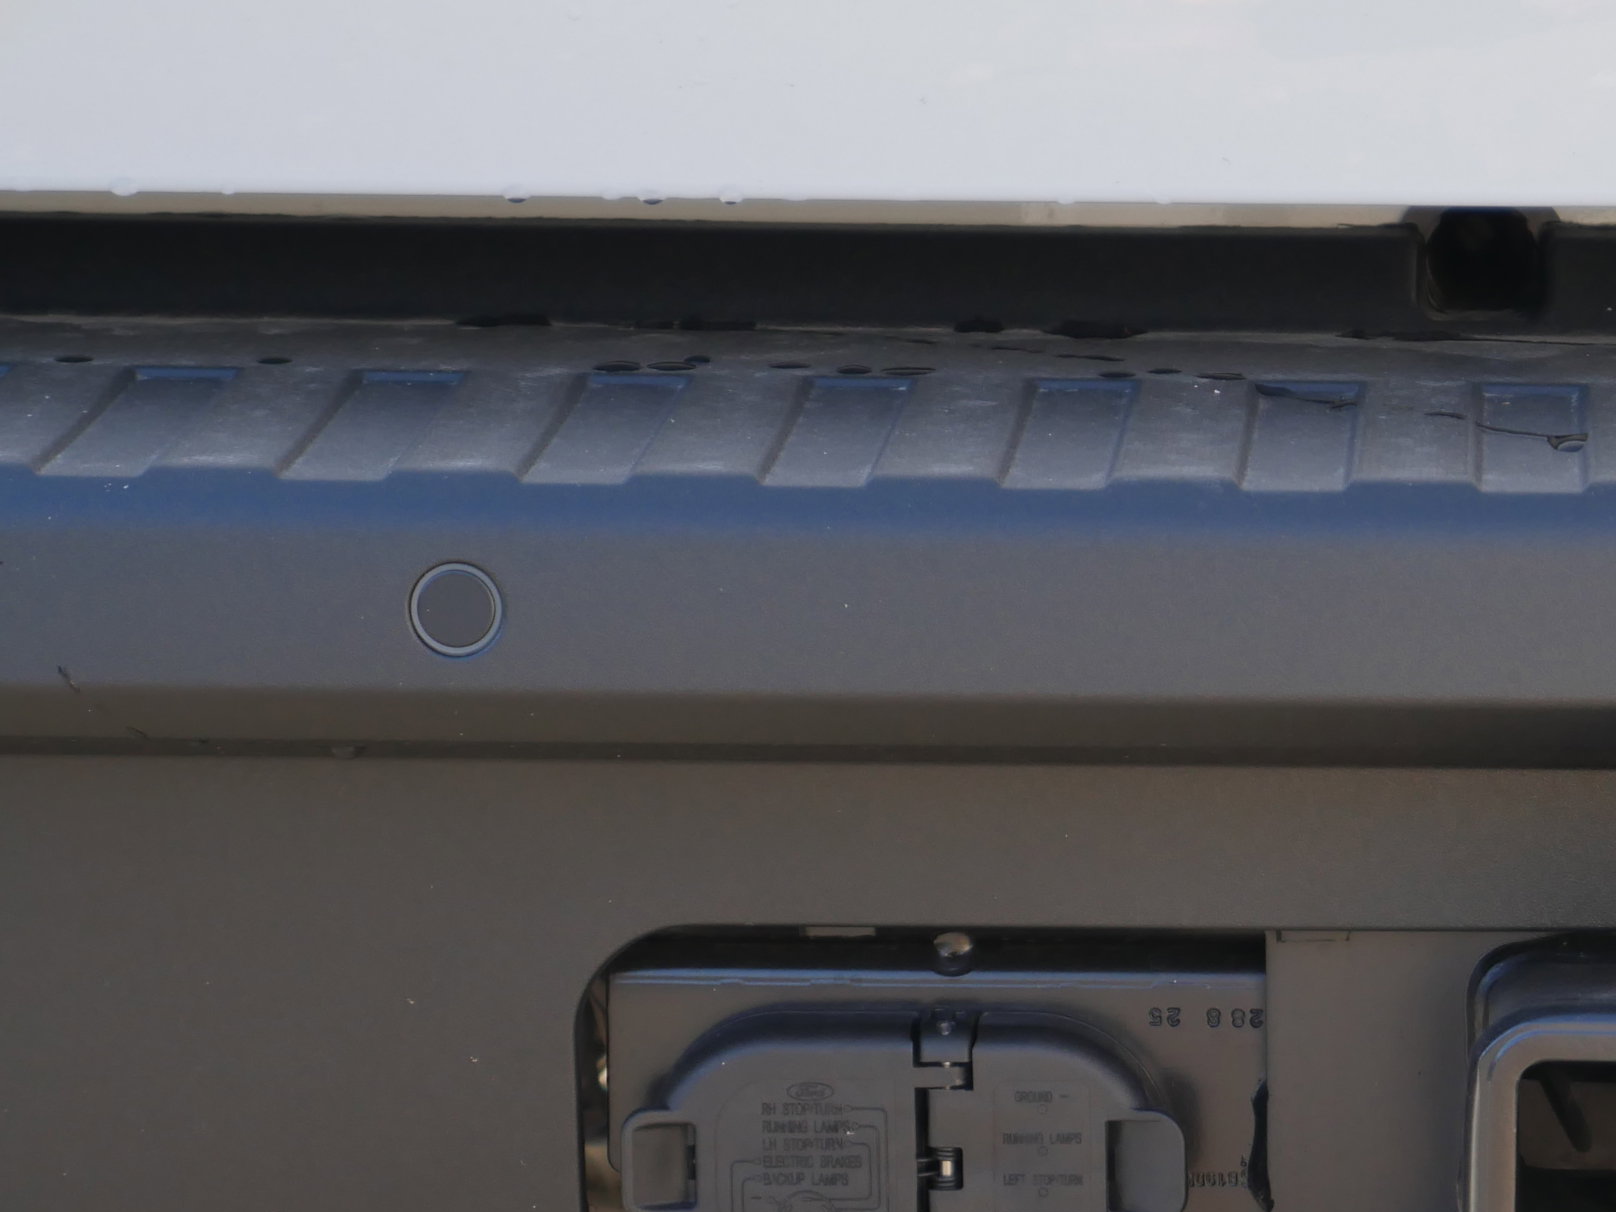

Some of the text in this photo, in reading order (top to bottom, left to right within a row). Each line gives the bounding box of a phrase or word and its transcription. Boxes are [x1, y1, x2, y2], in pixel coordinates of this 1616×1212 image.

[1013, 1090, 1053, 1104] GROUND
[761, 1102, 777, 1116] RH
[761, 1119, 809, 1134] RUNNING
[1002, 1131, 1083, 1145] RUNNING LAMPS
[762, 1155, 863, 1169] ELECTRIC BRAKES
[762, 1172, 849, 1186] BACKUP LAMPS
[1003, 1173, 1025, 1186] LEFT
